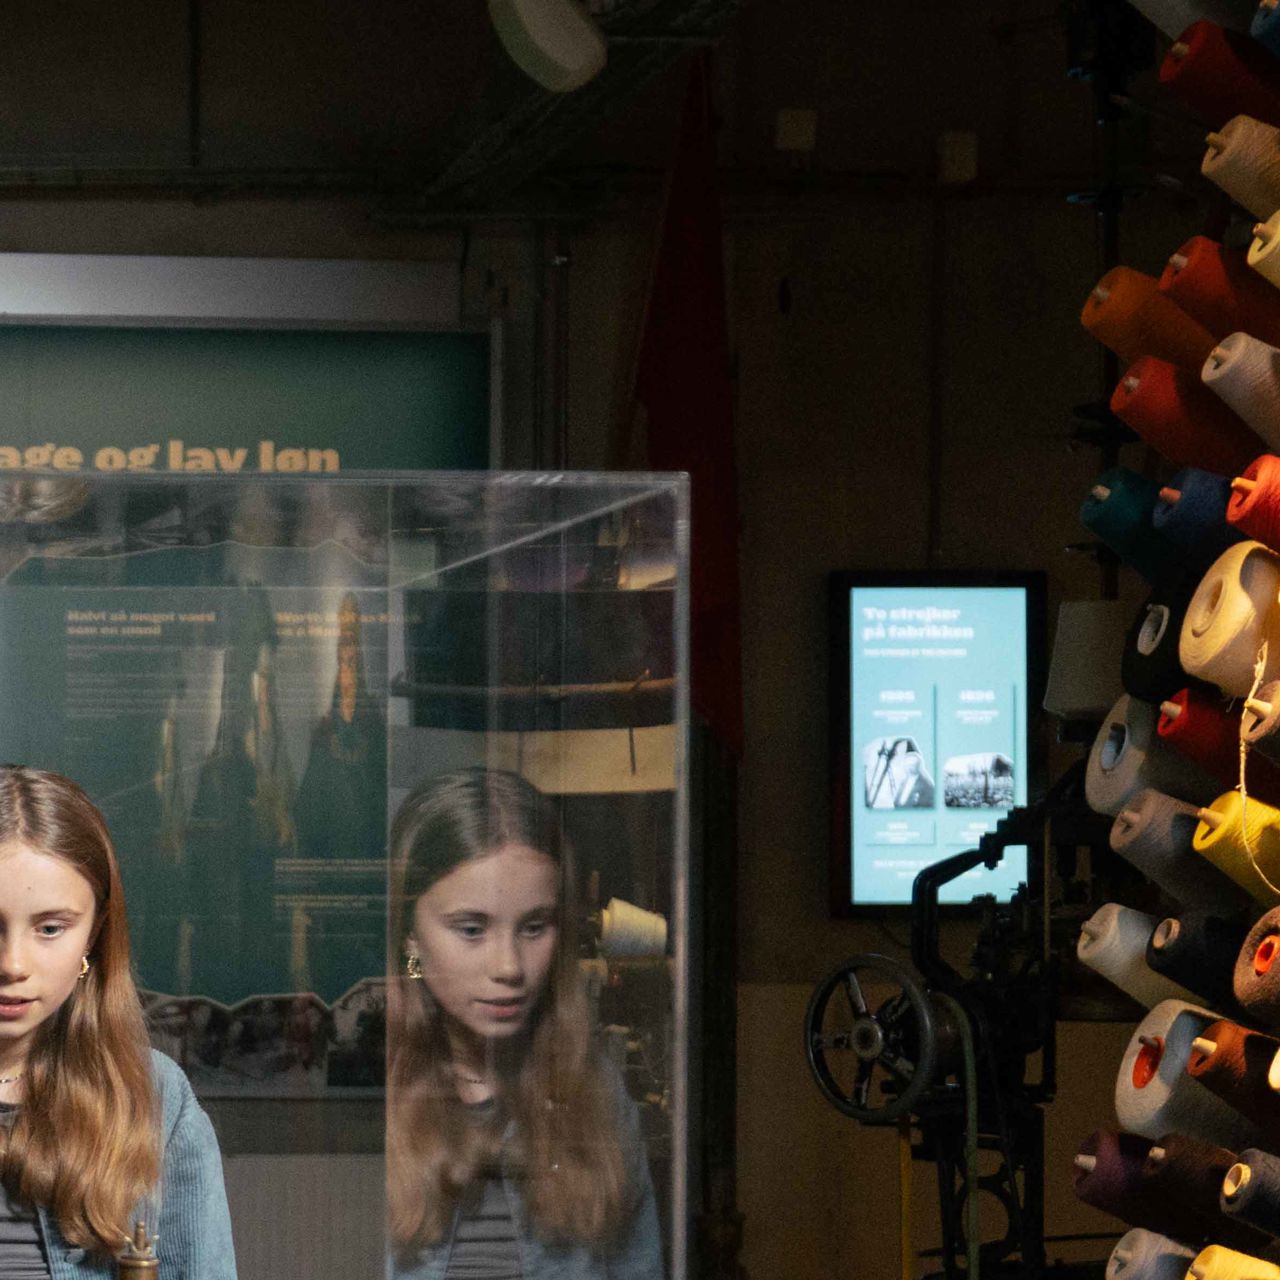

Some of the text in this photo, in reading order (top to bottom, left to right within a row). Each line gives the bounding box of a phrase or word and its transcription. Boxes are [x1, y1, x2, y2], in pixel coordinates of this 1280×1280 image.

[95, 442, 159, 473] og
[168, 439, 248, 473] lav
[257, 439, 341, 473] løn
[863, 607, 887, 620] To
[863, 622, 886, 641] på
